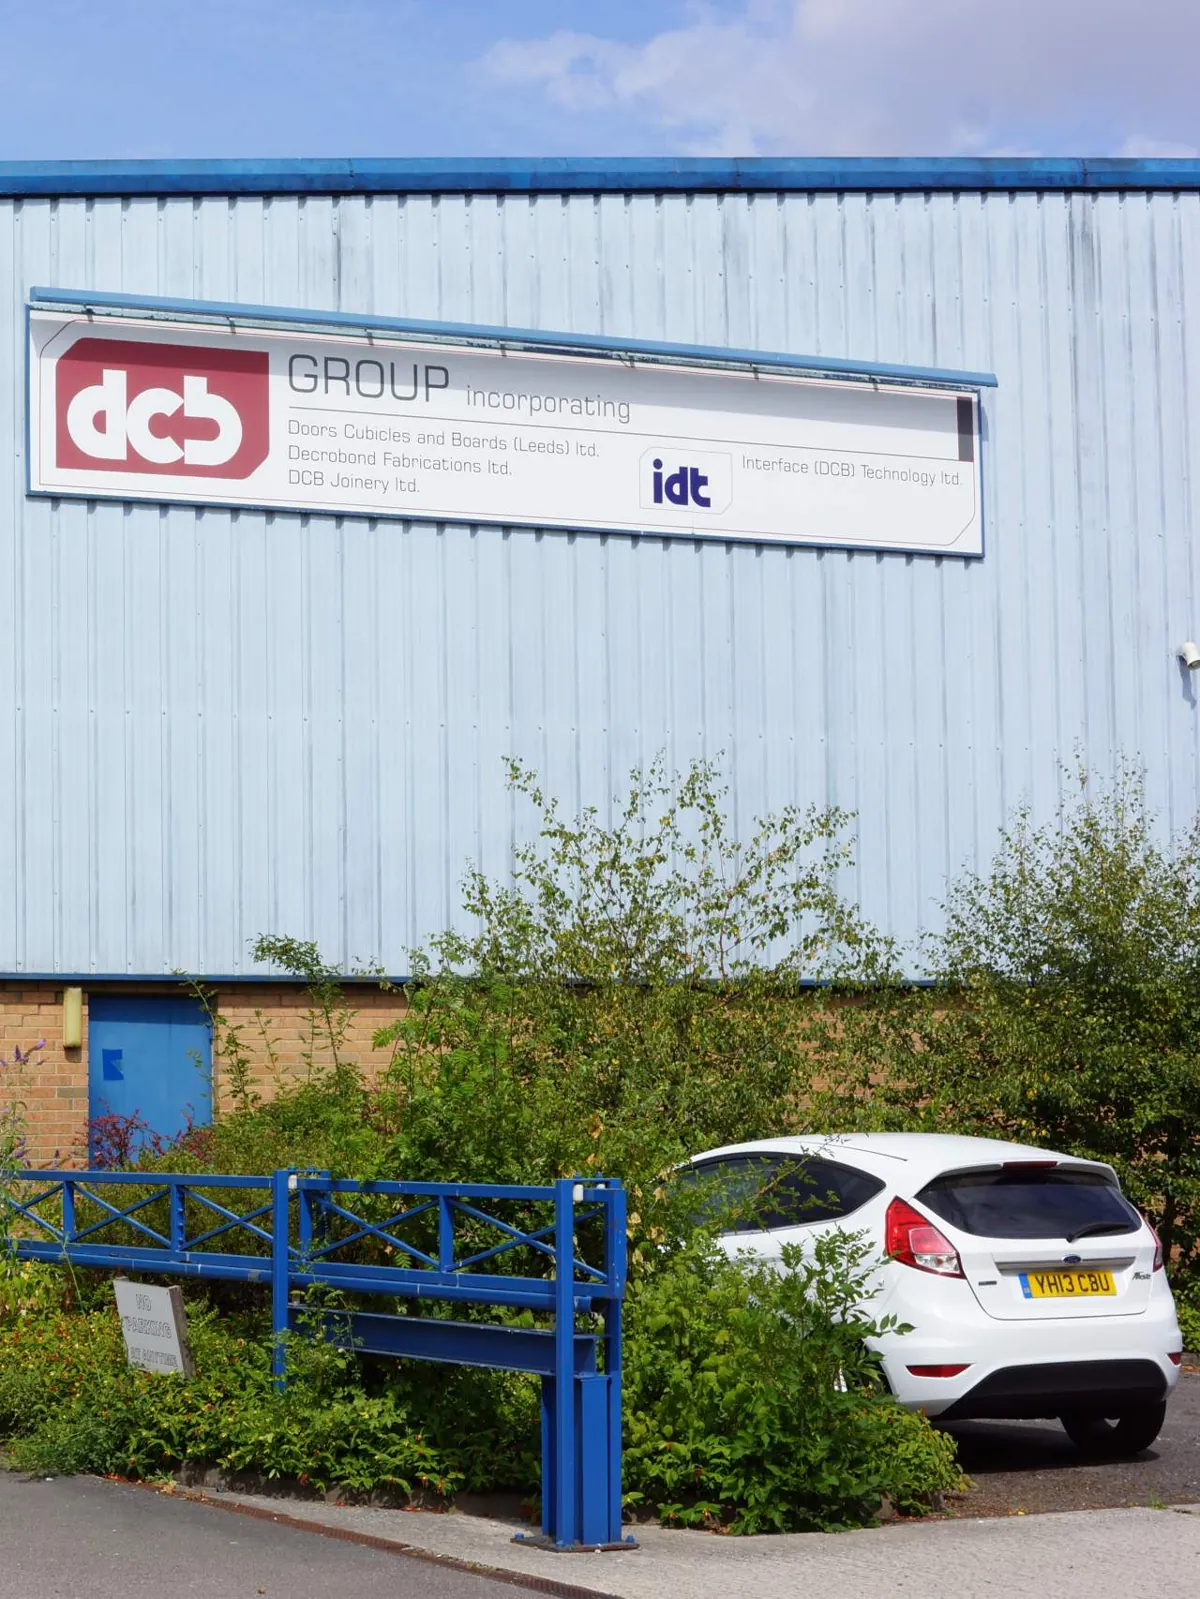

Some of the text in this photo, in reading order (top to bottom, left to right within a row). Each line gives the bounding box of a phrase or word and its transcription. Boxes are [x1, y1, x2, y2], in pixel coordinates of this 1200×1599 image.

[289, 353, 631, 424] GROUP incorporating
[67, 368, 243, 466] dcb
[288, 419, 600, 457] Doors Cubicles and Boards (Leeds) ltd.
[288, 445, 512, 475] Decrobond Fabrications ltd.
[742, 455, 963, 487] Interface (DCB) Technology ltd.
[288, 469, 420, 494] DCB Joinery ltd.
[653, 458, 711, 508] idt
[1034, 1272, 1110, 1295] YH13 CBU
[135, 1293, 151, 1311] NO
[127, 1317, 172, 1339] PARKING
